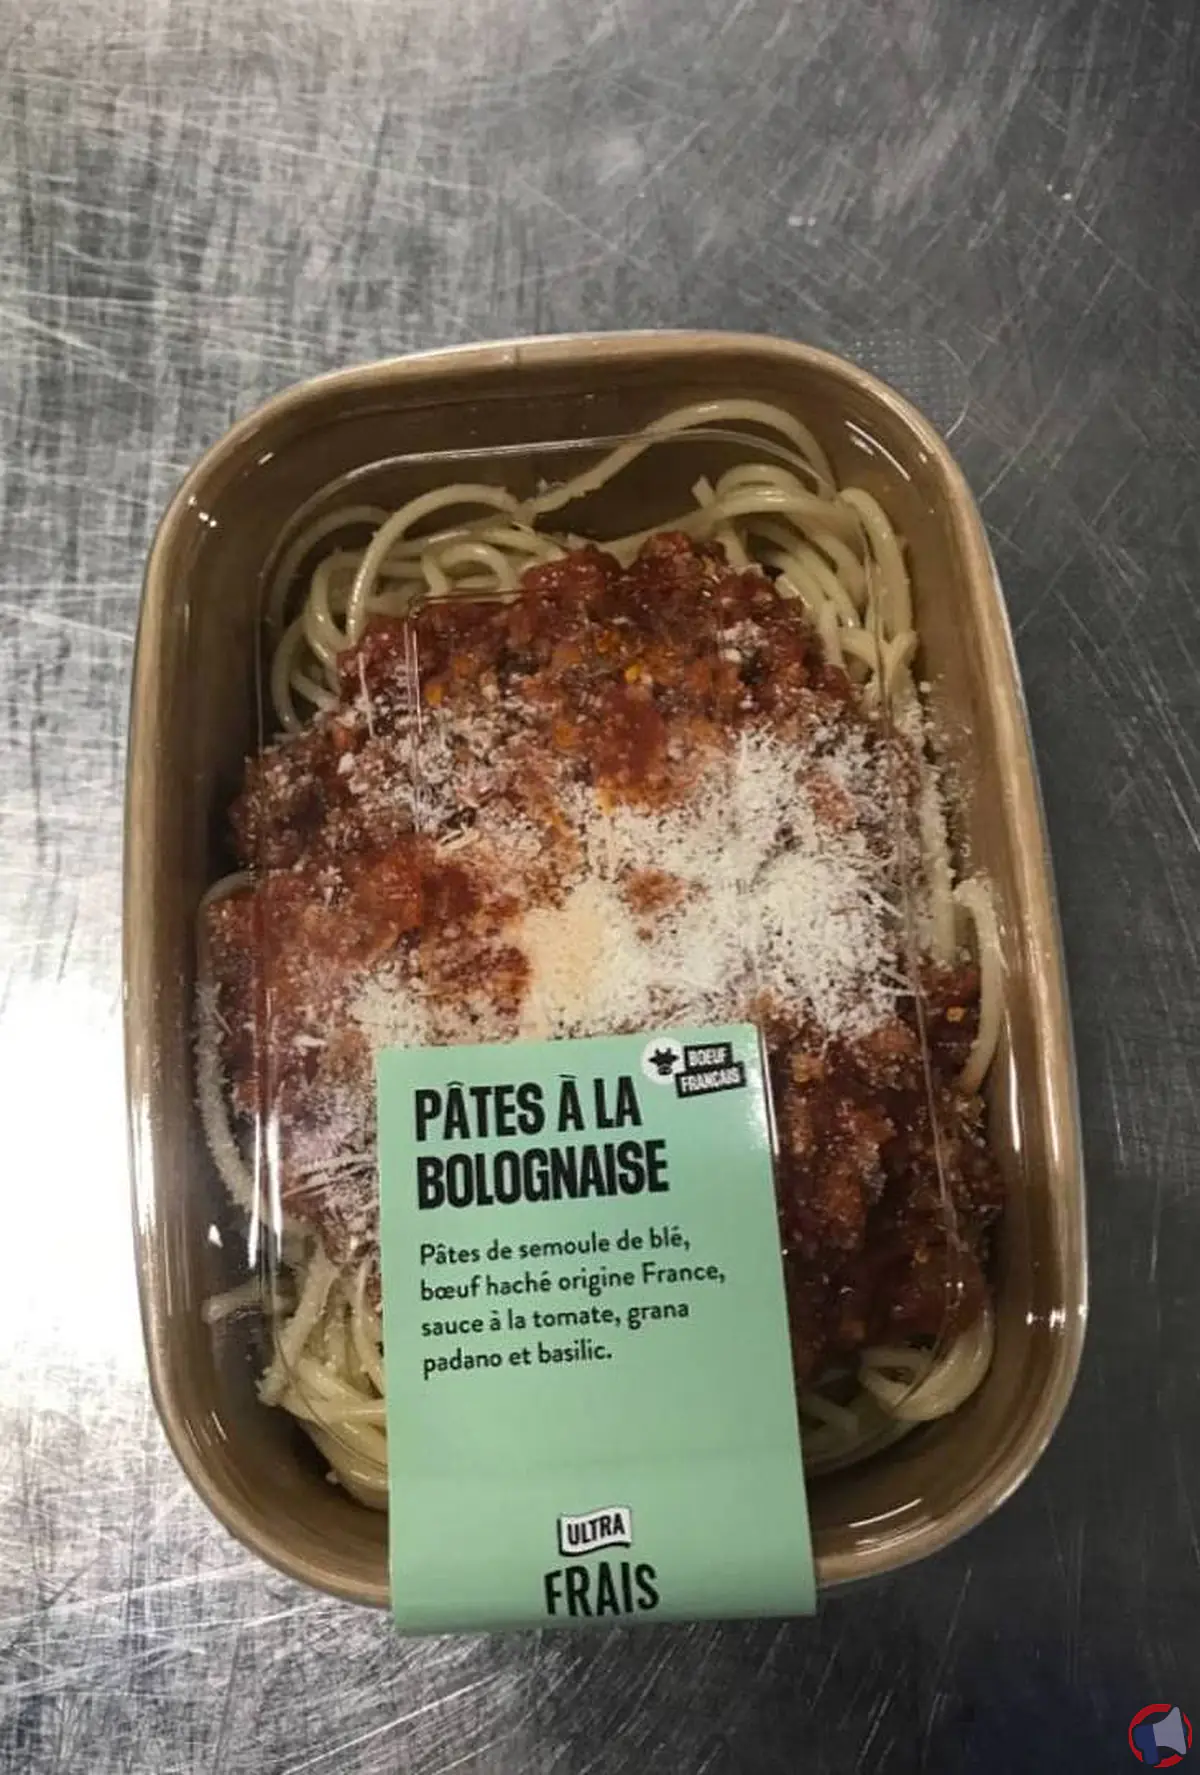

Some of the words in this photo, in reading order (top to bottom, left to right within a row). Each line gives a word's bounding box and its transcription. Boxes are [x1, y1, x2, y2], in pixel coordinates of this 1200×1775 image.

[687, 1047, 727, 1066] BOEUF
[415, 1081, 545, 1142] PÂTES
[558, 1074, 585, 1132] À
[594, 1076, 642, 1129] LA
[417, 1139, 669, 1209] BOLOGNAISE
[420, 1241, 480, 1266] Pâtes
[487, 1237, 512, 1262] de
[519, 1232, 610, 1259] semoule
[616, 1230, 643, 1251] de
[649, 1225, 690, 1250] blé,
[421, 1274, 481, 1300] bœuf
[486, 1267, 551, 1296] haché
[559, 1267, 635, 1297] origine
[642, 1262, 725, 1285] France,
[422, 1316, 484, 1337] sauce
[489, 1310, 500, 1331] à
[508, 1308, 527, 1330] la
[533, 1305, 621, 1329] tomate,
[627, 1302, 689, 1330] grana
[423, 1346, 502, 1380] padano
[509, 1341, 530, 1365] et
[538, 1338, 612, 1364] basilic.
[567, 1512, 626, 1545] ULTRA
[544, 1561, 660, 1616] FRAIS
